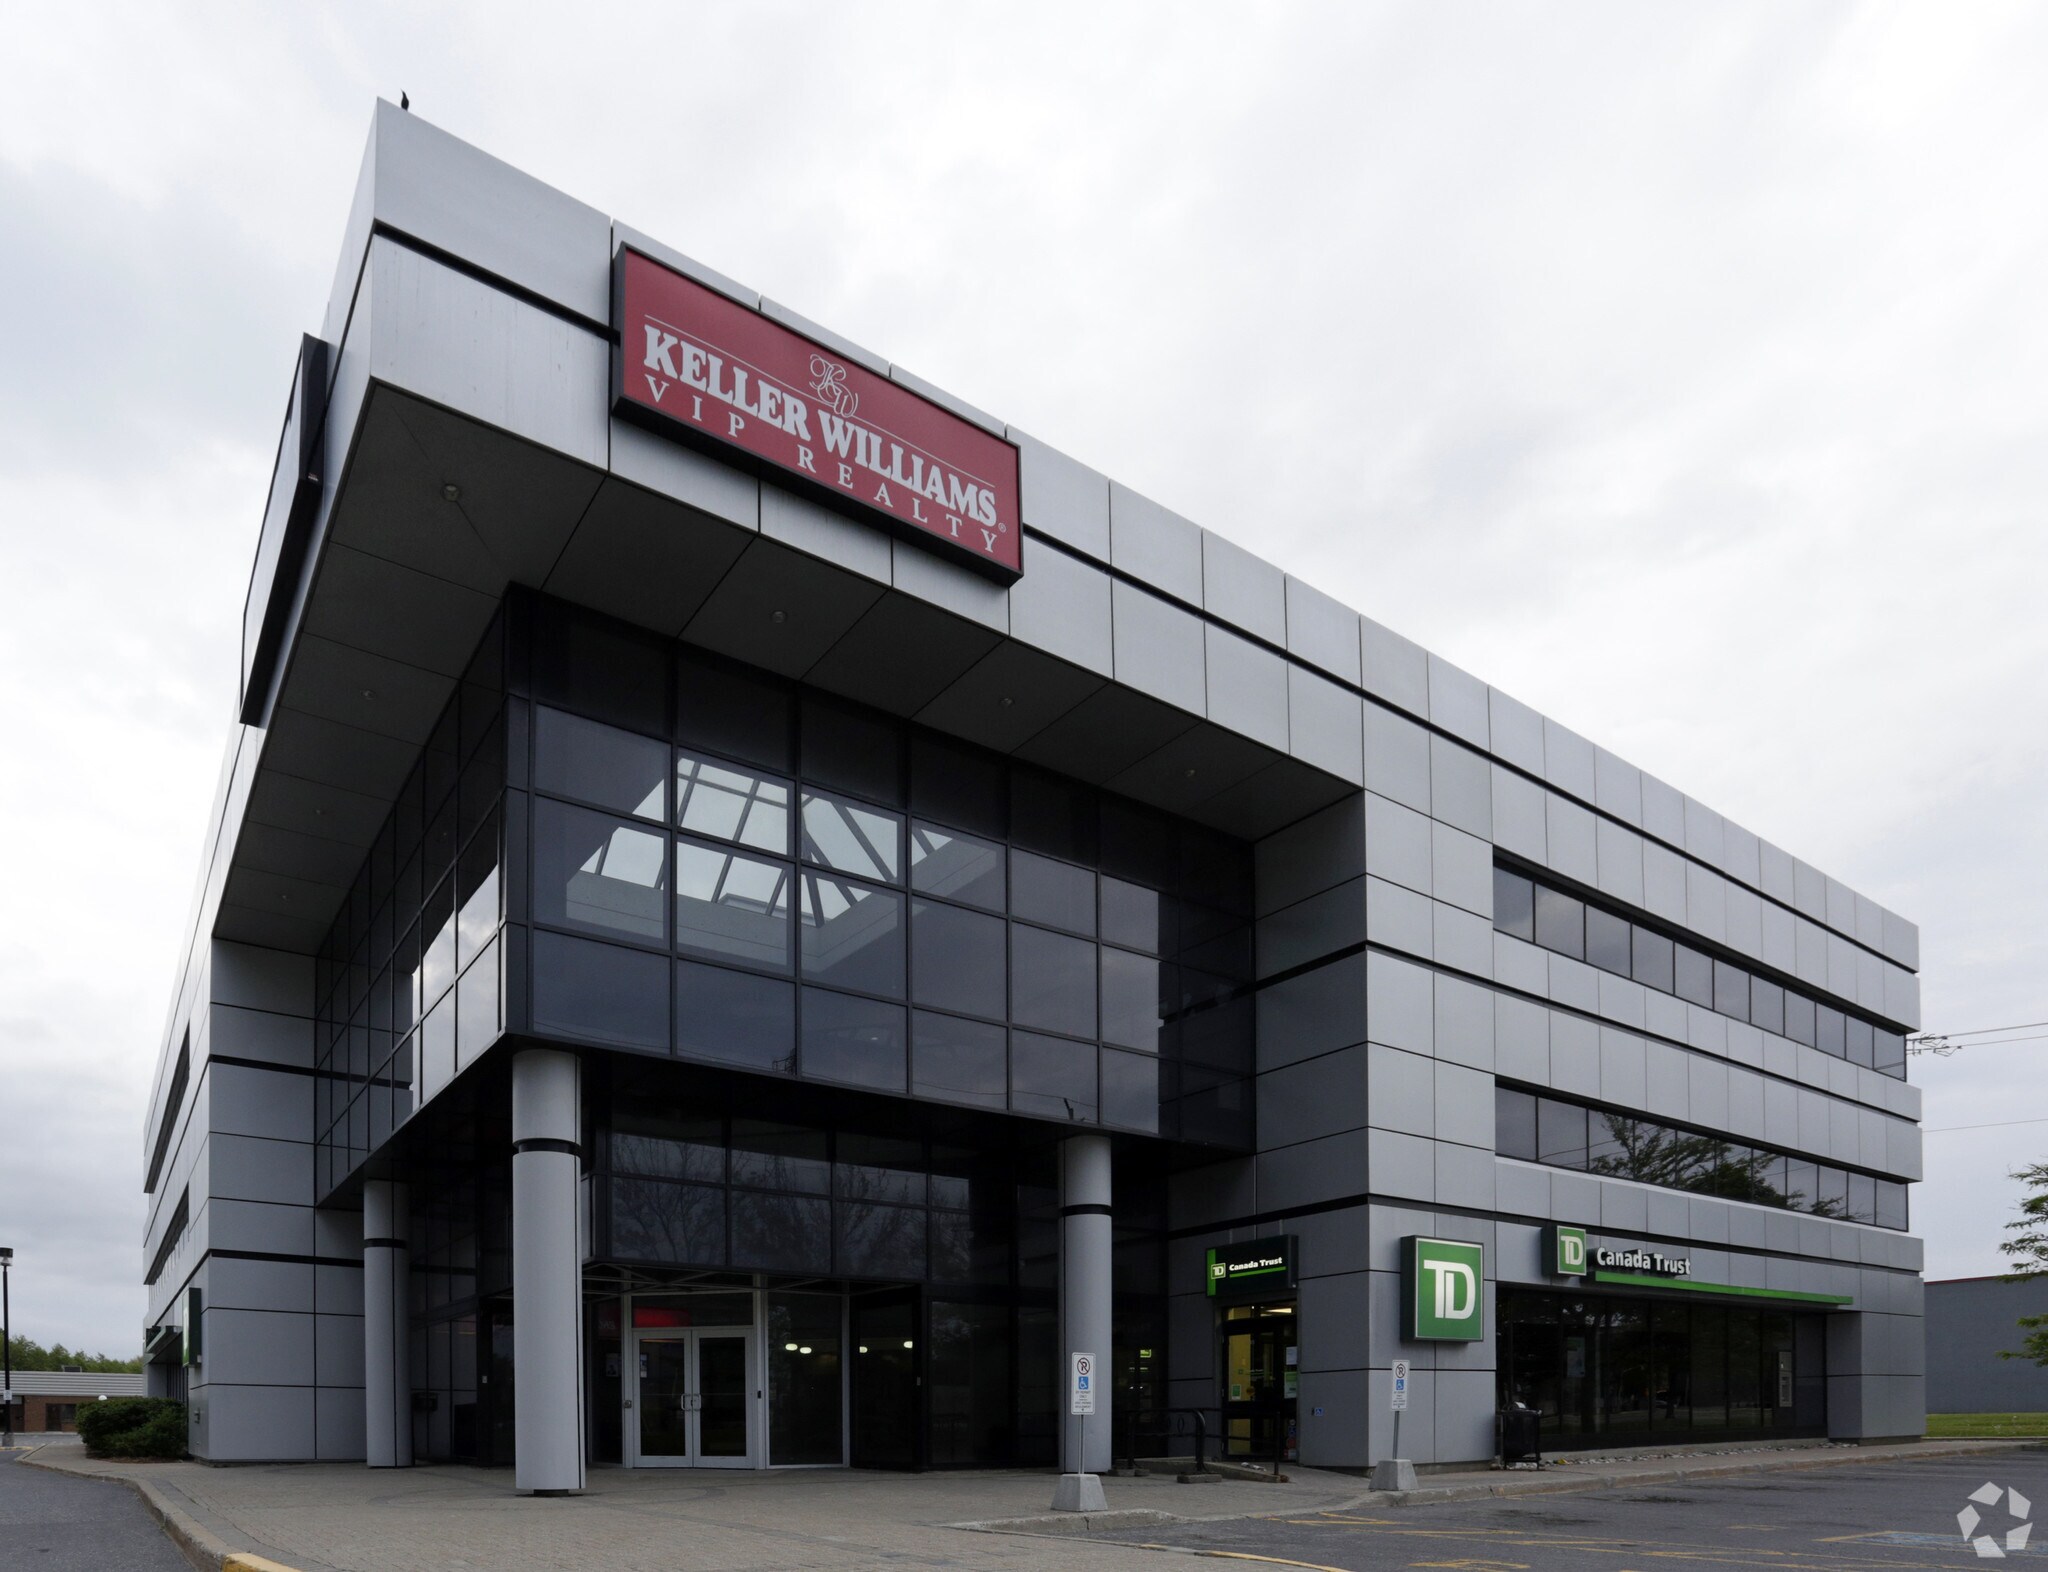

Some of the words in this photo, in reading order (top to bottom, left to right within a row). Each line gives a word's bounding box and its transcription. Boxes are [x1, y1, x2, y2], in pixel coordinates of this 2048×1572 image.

[643, 324, 812, 442] KELLER
[817, 409, 998, 528] WILLIAMS
[644, 373, 745, 438] VIP
[797, 443, 998, 553] REALTY
[1212, 1265, 1224, 1277] TD
[1229, 1260, 1259, 1271] Canada
[1259, 1256, 1283, 1267] Trust
[1559, 1235, 1584, 1266] TD
[1596, 1247, 1652, 1270] Canada
[1653, 1253, 1691, 1275] Trust
[1423, 1259, 1476, 1320] TD
